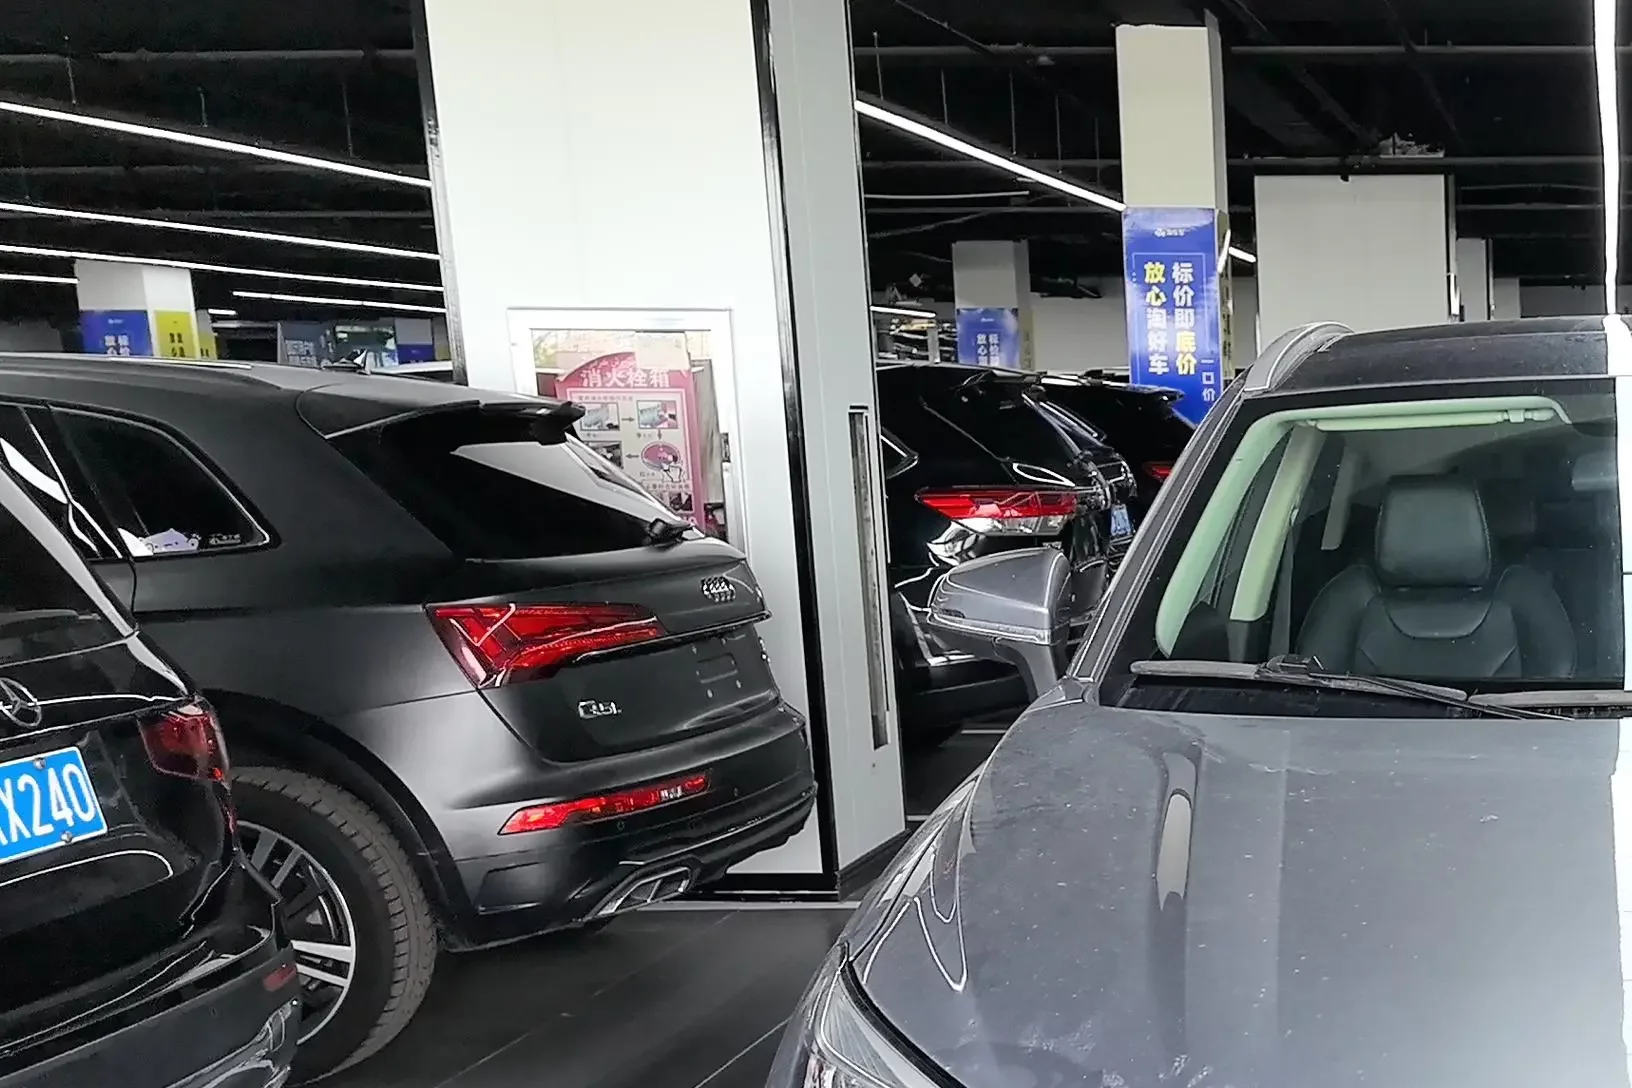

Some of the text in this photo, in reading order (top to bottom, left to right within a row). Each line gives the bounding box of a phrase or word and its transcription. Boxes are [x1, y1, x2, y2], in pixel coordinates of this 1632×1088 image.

[1143, 261, 1170, 376] 放心淘好车
[1172, 262, 1197, 376] 标价即底价
[580, 368, 671, 388] 消火栓箱
[1201, 359, 1216, 402] 一口价
[0, 763, 96, 846] X240
